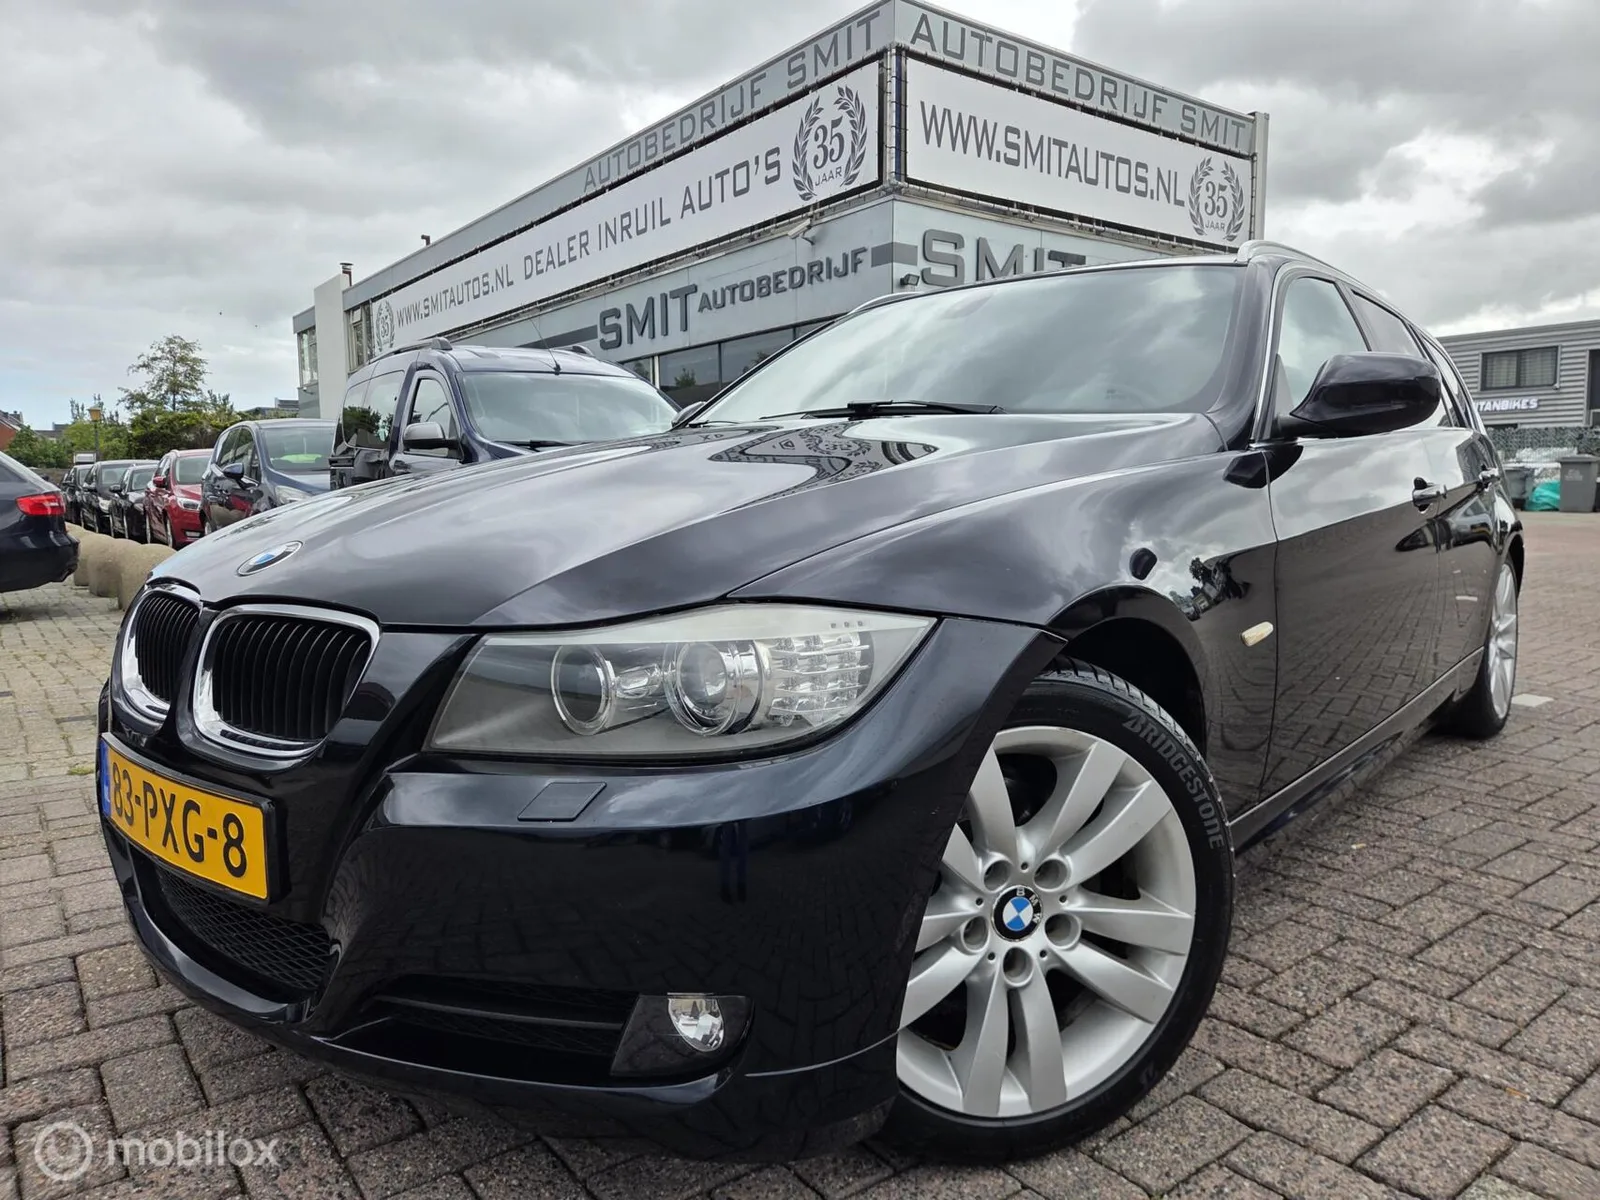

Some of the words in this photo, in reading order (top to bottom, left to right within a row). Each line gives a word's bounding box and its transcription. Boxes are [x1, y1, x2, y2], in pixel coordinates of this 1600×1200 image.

[583, 72, 767, 193] AUTOBEDRIJF
[787, 11, 881, 89] SMIT
[910, 13, 1168, 123] AUTOBEDRIJF
[1180, 104, 1246, 149] SMIT
[813, 115, 845, 169] 35
[815, 166, 842, 187] JAAR
[920, 101, 1185, 207] WWW.SMITAUTOS.NL
[397, 265, 514, 328] WWW.SMITAUTOS.NL
[523, 229, 590, 280] DEALER
[598, 197, 671, 251] INRUIL
[680, 146, 781, 219] AUTO'S
[1204, 181, 1228, 218] 35
[1205, 220, 1226, 232] JAAR
[599, 283, 698, 351] SMIT
[697, 247, 868, 313] AUTOBEDRIJF
[112, 762, 247, 878] 83-PXG-8
[1122, 710, 1225, 849] BRIDGESTONE
